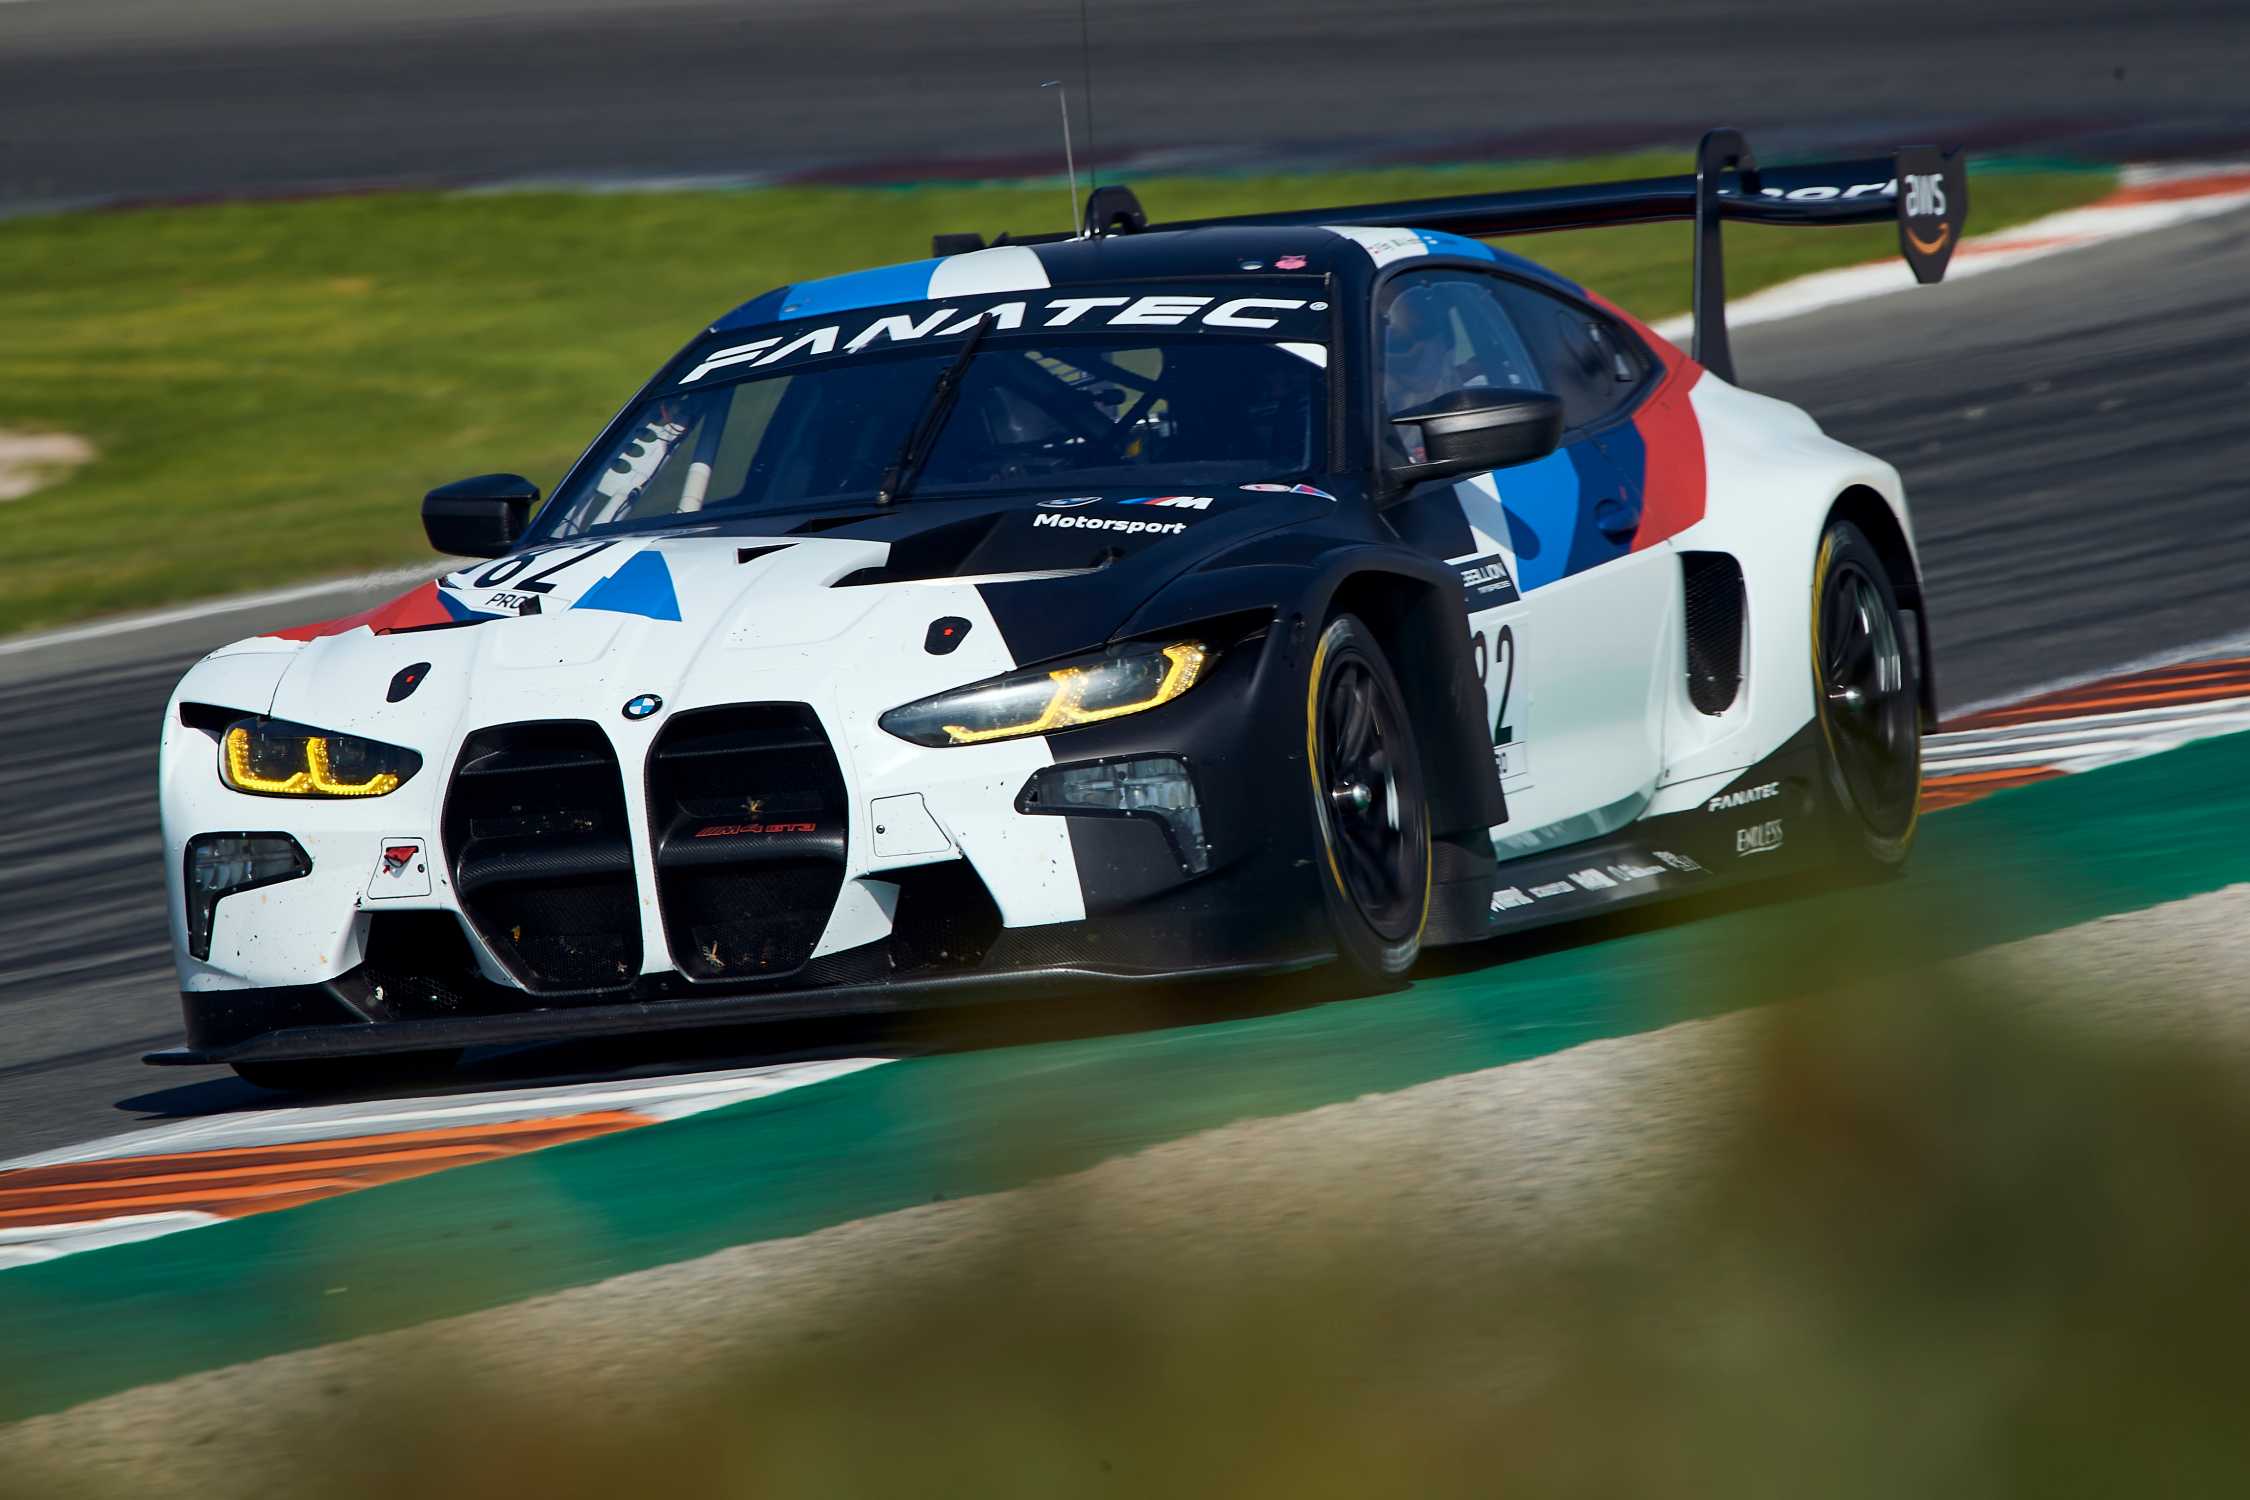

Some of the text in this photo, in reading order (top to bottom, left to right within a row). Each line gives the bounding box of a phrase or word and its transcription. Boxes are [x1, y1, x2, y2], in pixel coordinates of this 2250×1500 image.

[1904, 173, 1948, 217] aws
[678, 296, 1308, 385] FANATEC
[1033, 513, 1187, 534] Motorsport
[1707, 781, 1780, 812] FANATEC
